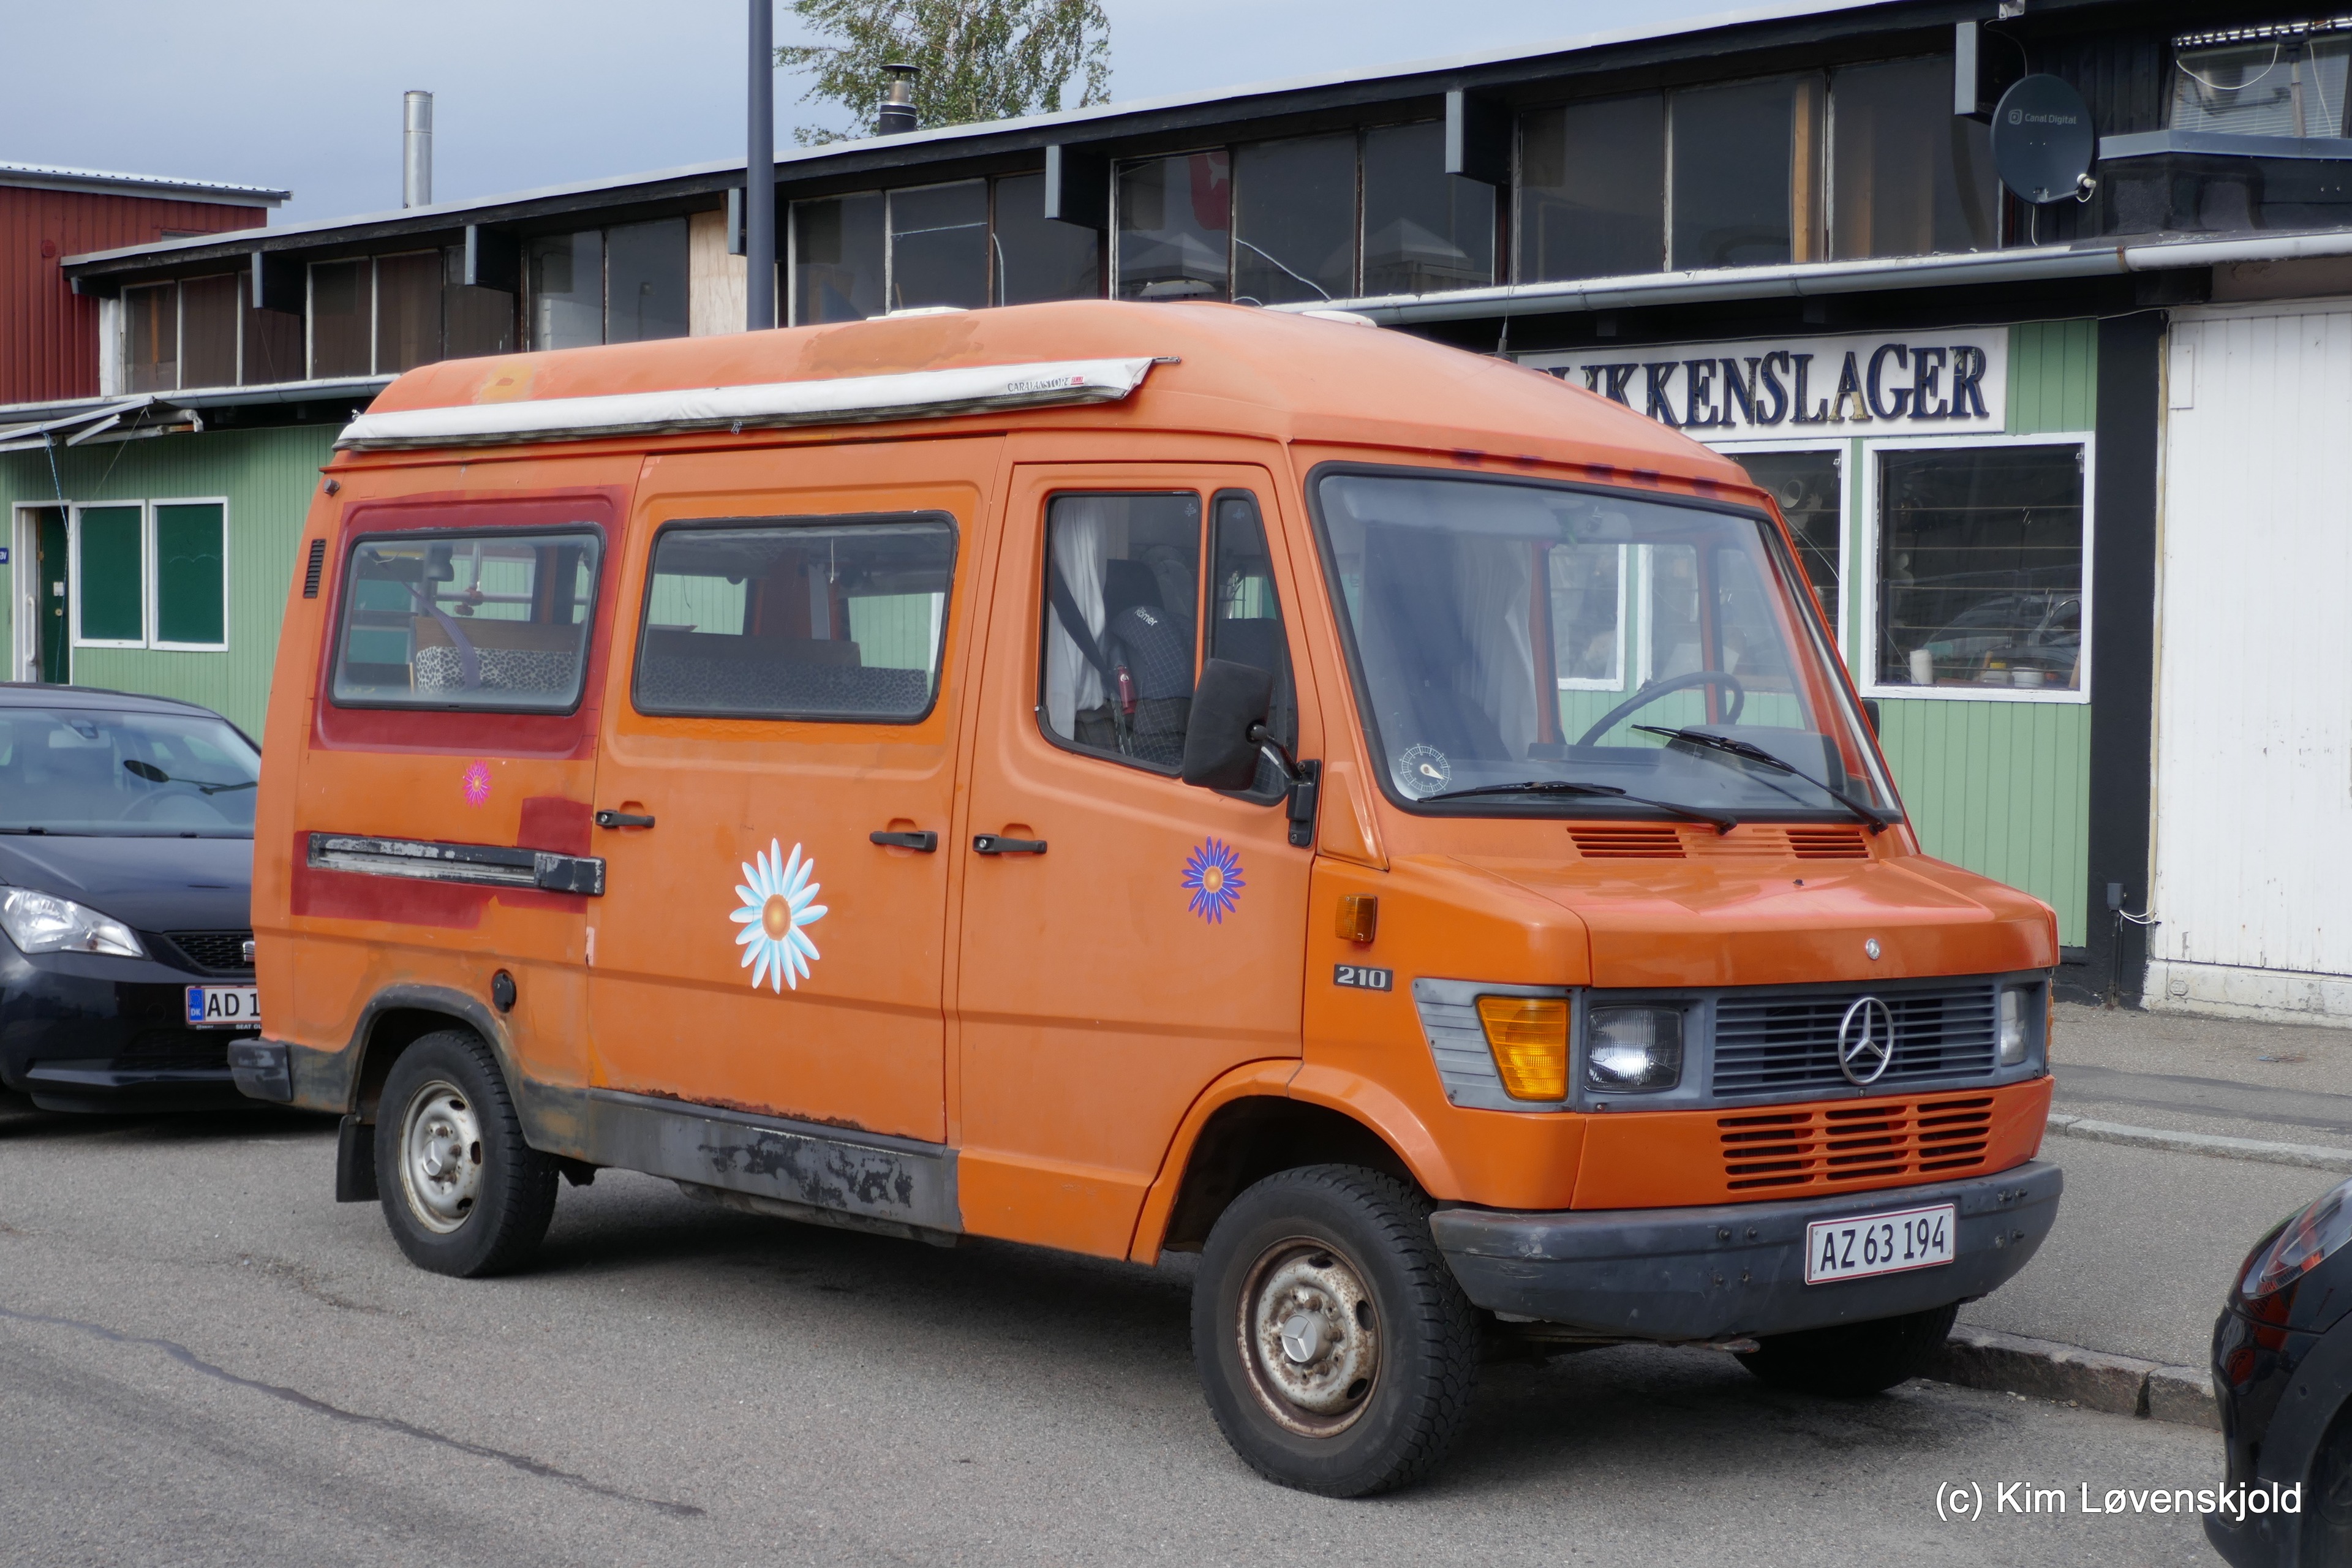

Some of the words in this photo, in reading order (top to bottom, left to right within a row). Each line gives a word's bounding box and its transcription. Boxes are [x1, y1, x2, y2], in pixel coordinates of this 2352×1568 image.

[2025, 113, 2047, 123] Canal
[2048, 115, 2076, 125] Digital
[1531, 343, 1990, 431] KKENSLAGER
[1337, 966, 1385, 988] 210
[206, 993, 239, 1017] AD
[1820, 1229, 1856, 1272] AZ
